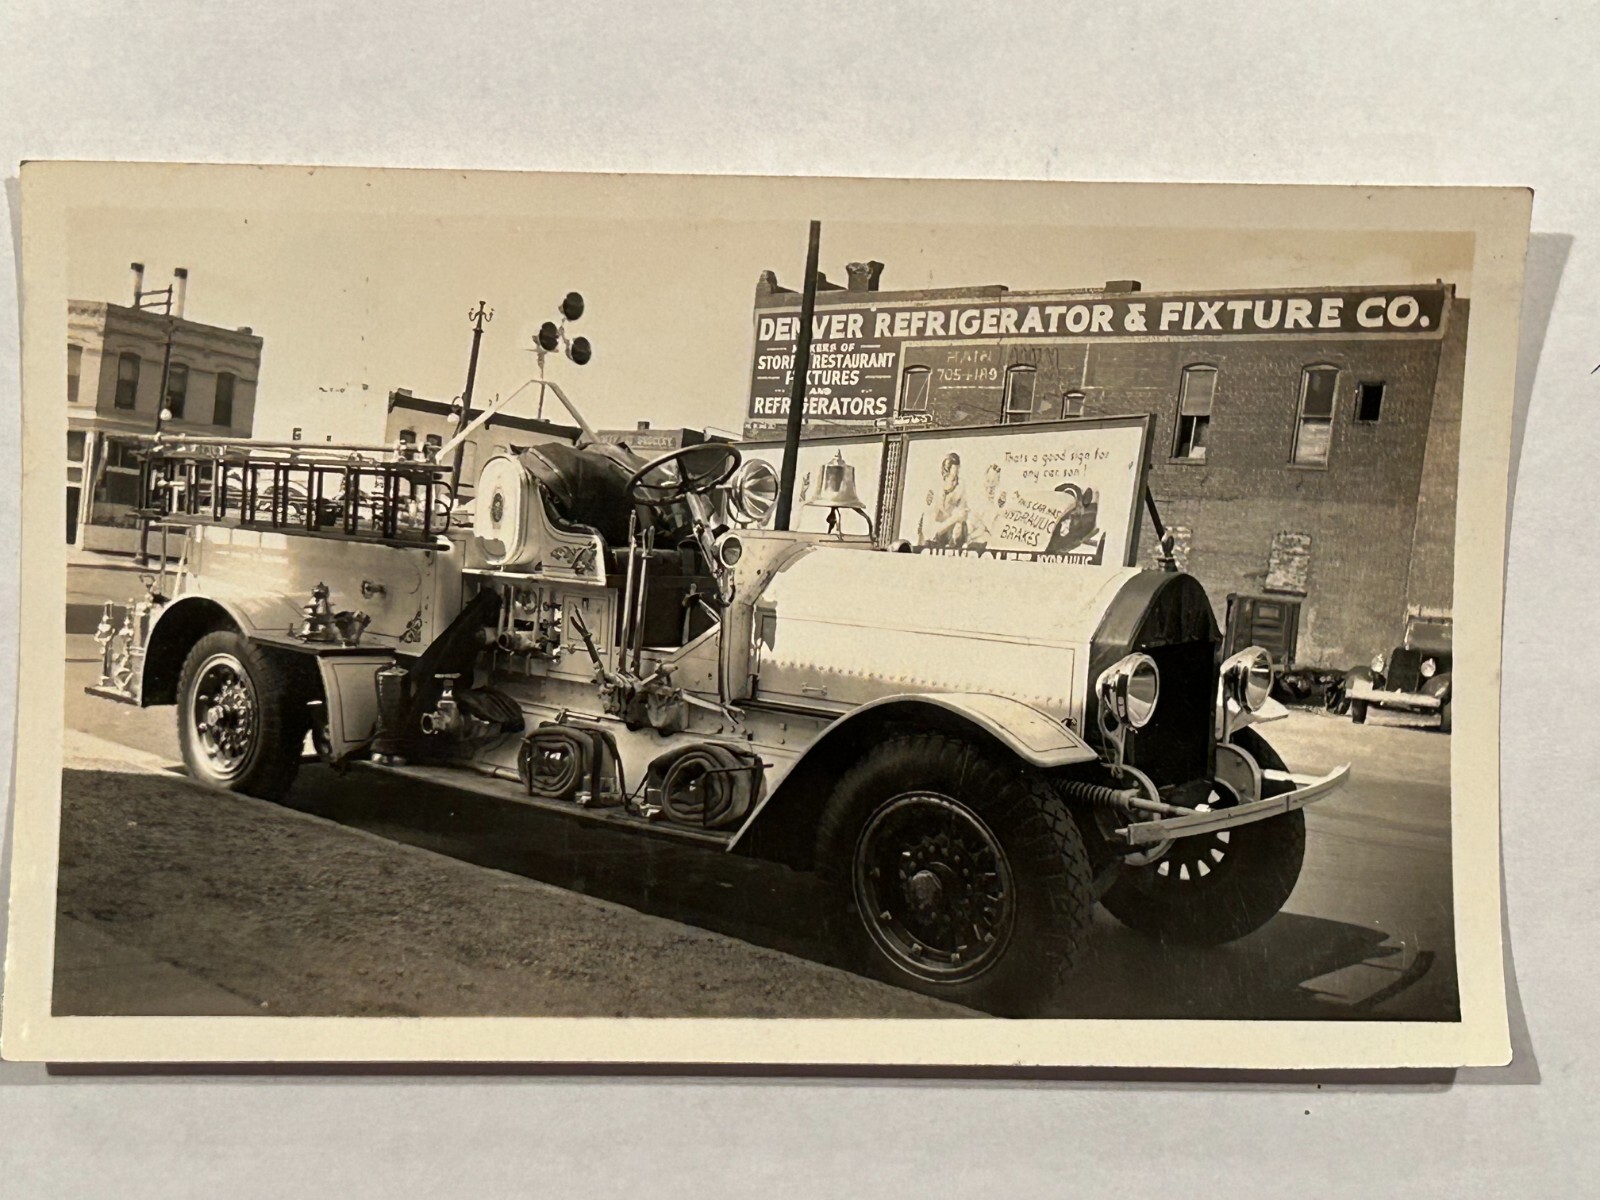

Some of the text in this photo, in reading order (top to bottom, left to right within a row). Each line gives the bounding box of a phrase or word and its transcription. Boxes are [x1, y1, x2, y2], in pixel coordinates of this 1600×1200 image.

[873, 304, 1114, 338] REFRIGERATOR
[1123, 303, 1148, 332] &
[1159, 297, 1344, 331] FIXTURE
[1356, 295, 1430, 329] CO.
[840, 343, 856, 353] OF
[812, 352, 896, 370] RESTAURANT
[785, 370, 860, 386] FXTURES
[808, 387, 832, 395] AND
[754, 396, 888, 416] REFRGERATORS
[1041, 449, 1066, 467] good
[1070, 451, 1090, 466] sign
[1094, 447, 1110, 461] for
[1022, 470, 1040, 481] any
[1000, 524, 1041, 547] BRAKES
